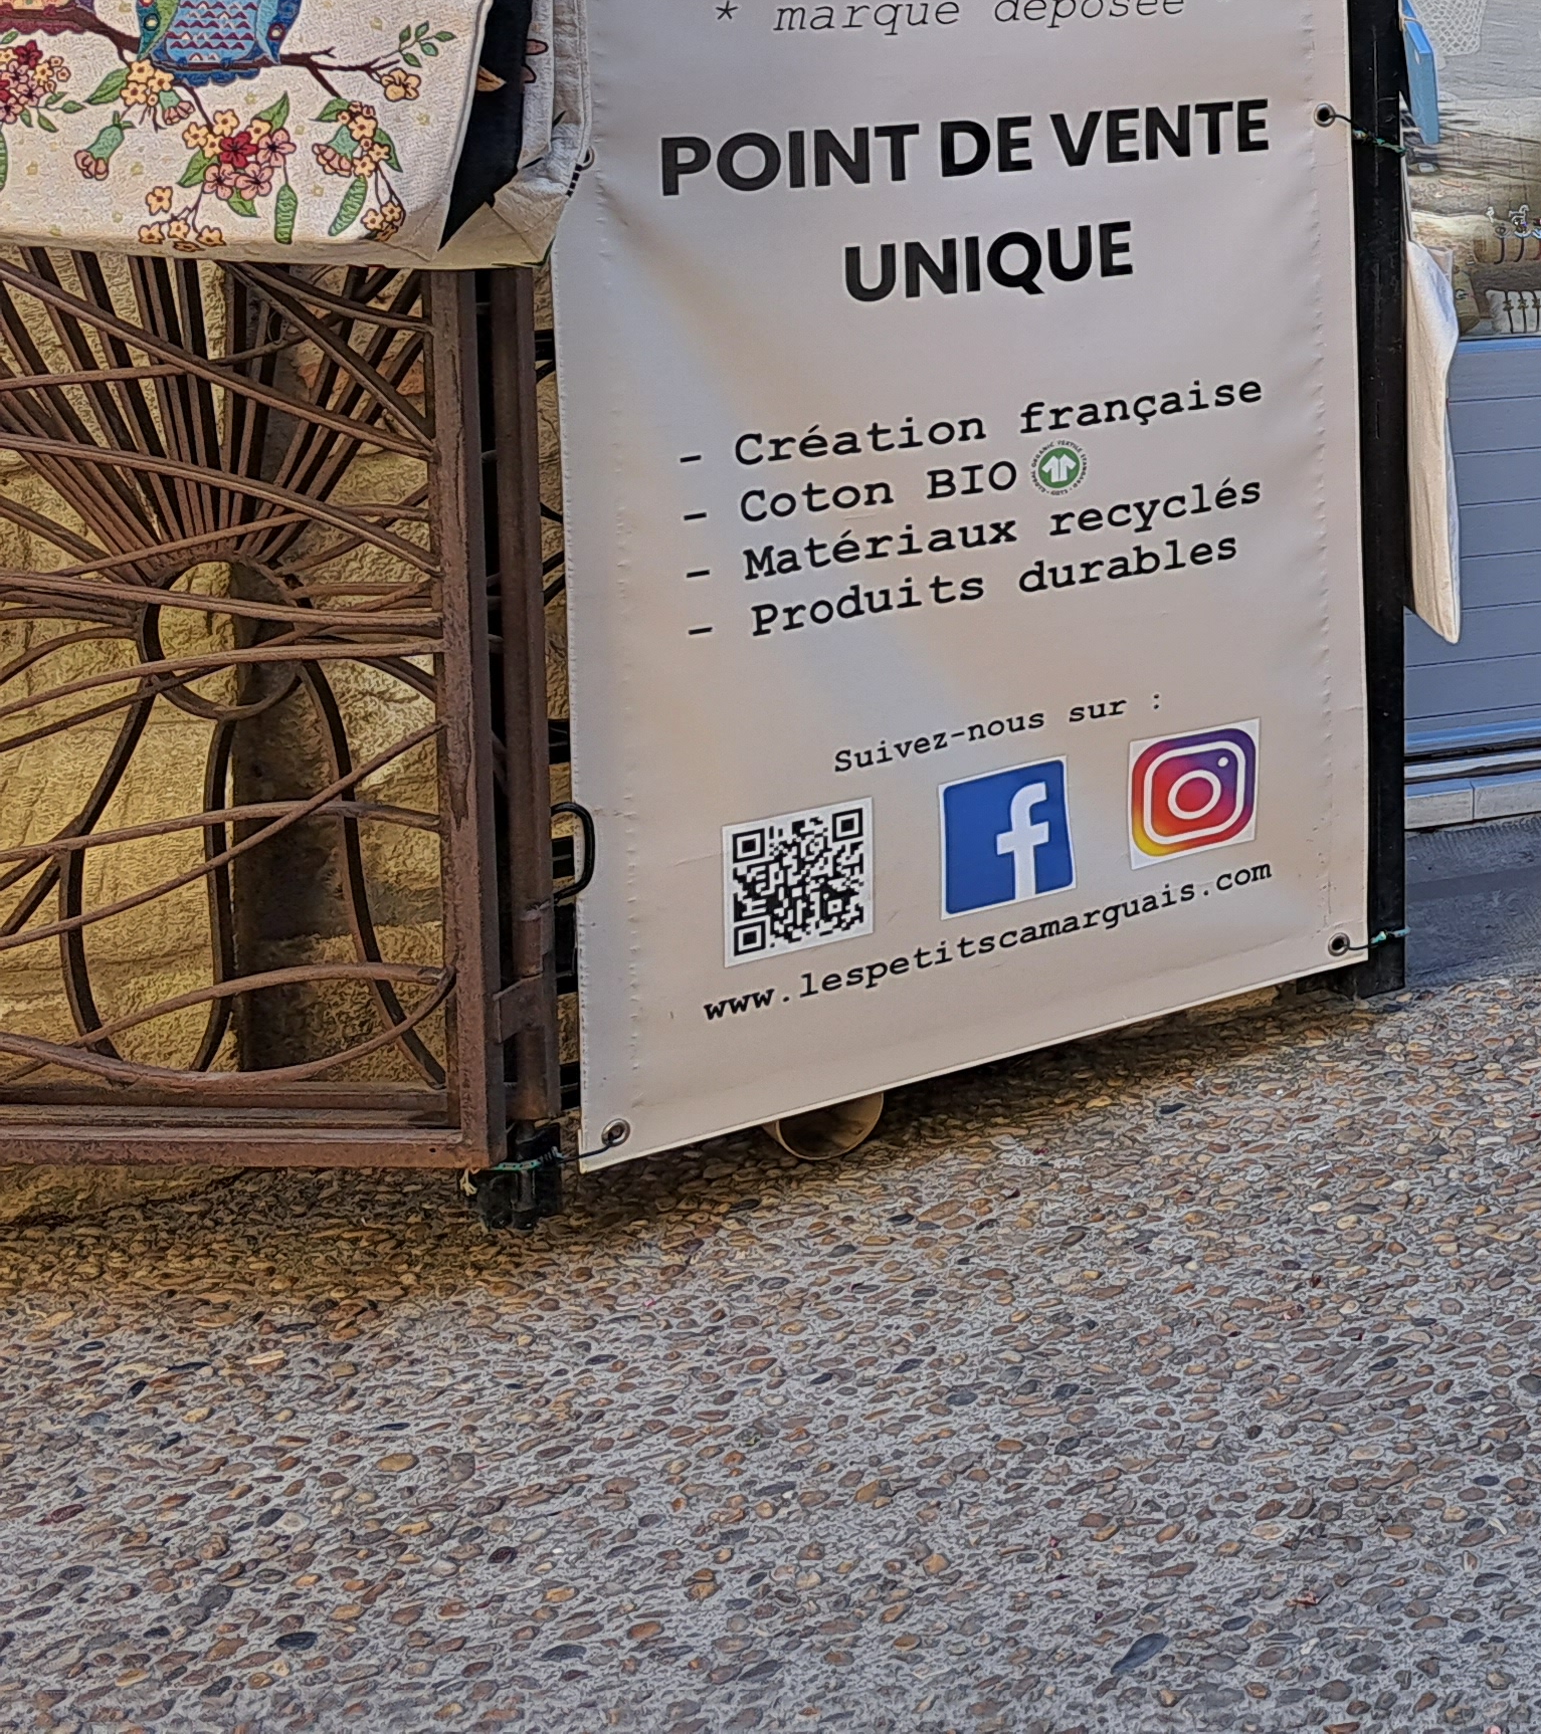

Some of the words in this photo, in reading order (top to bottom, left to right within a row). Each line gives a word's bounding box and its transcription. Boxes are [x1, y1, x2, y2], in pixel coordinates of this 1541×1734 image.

[773, 1, 960, 36] marque
[660, 123, 920, 197] POINT
[939, 114, 1033, 178] DE
[1048, 97, 1270, 168] VENTE
[844, 220, 1134, 303] UNIQUE
[734, 416, 987, 468] Création
[1019, 379, 1262, 433] française
[740, 481, 895, 523] Coton
[926, 460, 1018, 500] BIO
[744, 519, 1017, 580] Matériaux
[1049, 477, 1261, 536] recyclés
[752, 575, 985, 637] Produits
[1018, 538, 1237, 594] durables
[833, 712, 1046, 774] Suivez-nous
[1068, 698, 1128, 724] sur
[703, 860, 1273, 1022] www.lespetitscamarguais.com
